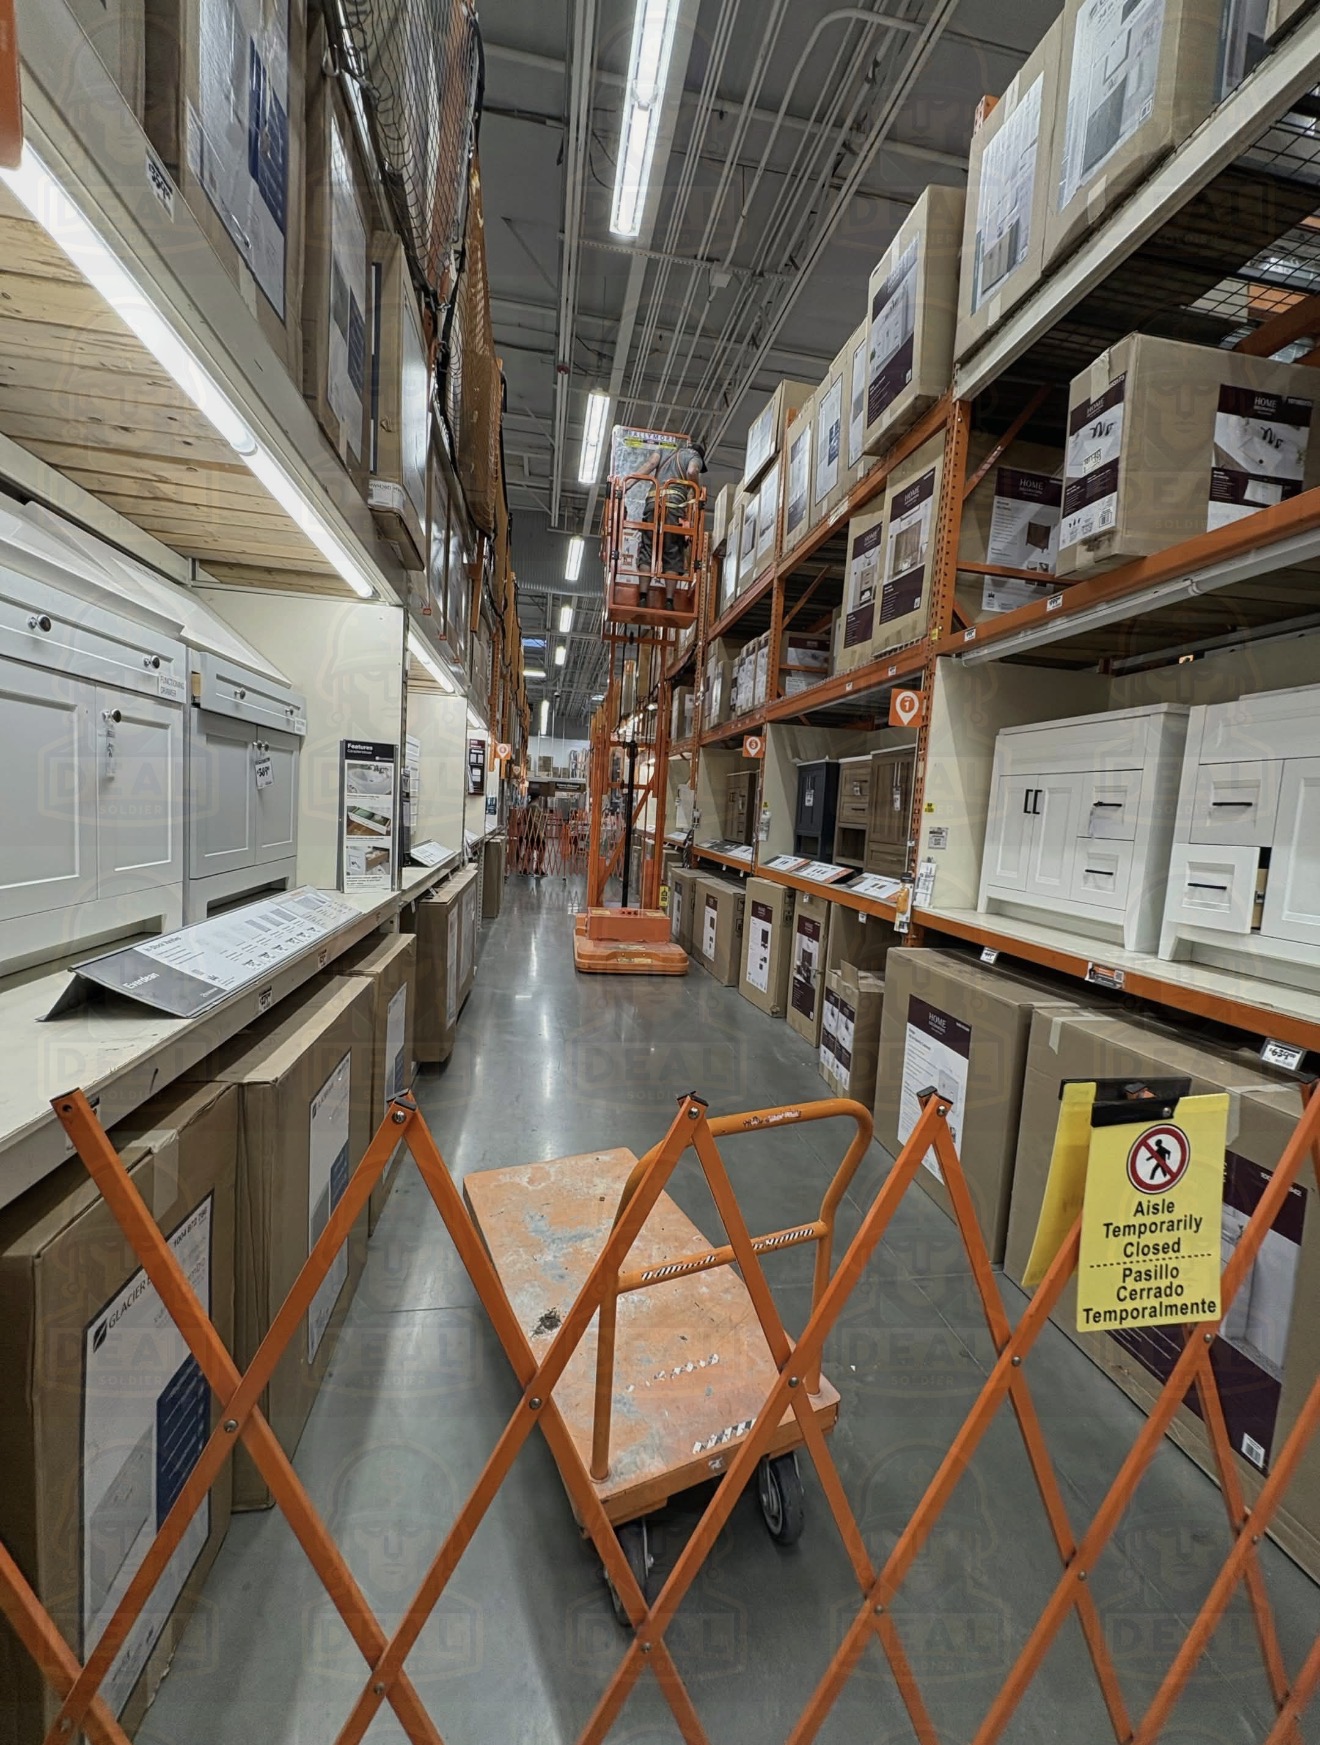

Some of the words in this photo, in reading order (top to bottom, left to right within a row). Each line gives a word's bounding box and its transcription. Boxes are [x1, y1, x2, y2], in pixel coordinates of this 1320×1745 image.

[1255, 396, 1277, 408] HOME
[904, 485, 920, 502] HOME
[1019, 478, 1044, 491] HOME
[347, 743, 373, 752] Features
[928, 1011, 947, 1029] HOME
[1133, 1198, 1175, 1217] Aisle
[1103, 1214, 1203, 1239] Temporarily
[1123, 1237, 1181, 1258] Closed
[1122, 1263, 1180, 1284] Pasillo
[1116, 1281, 1184, 1302] Cerrado
[108, 1280, 147, 1329] GLACIER
[1083, 1298, 1217, 1325] Temporalmente
